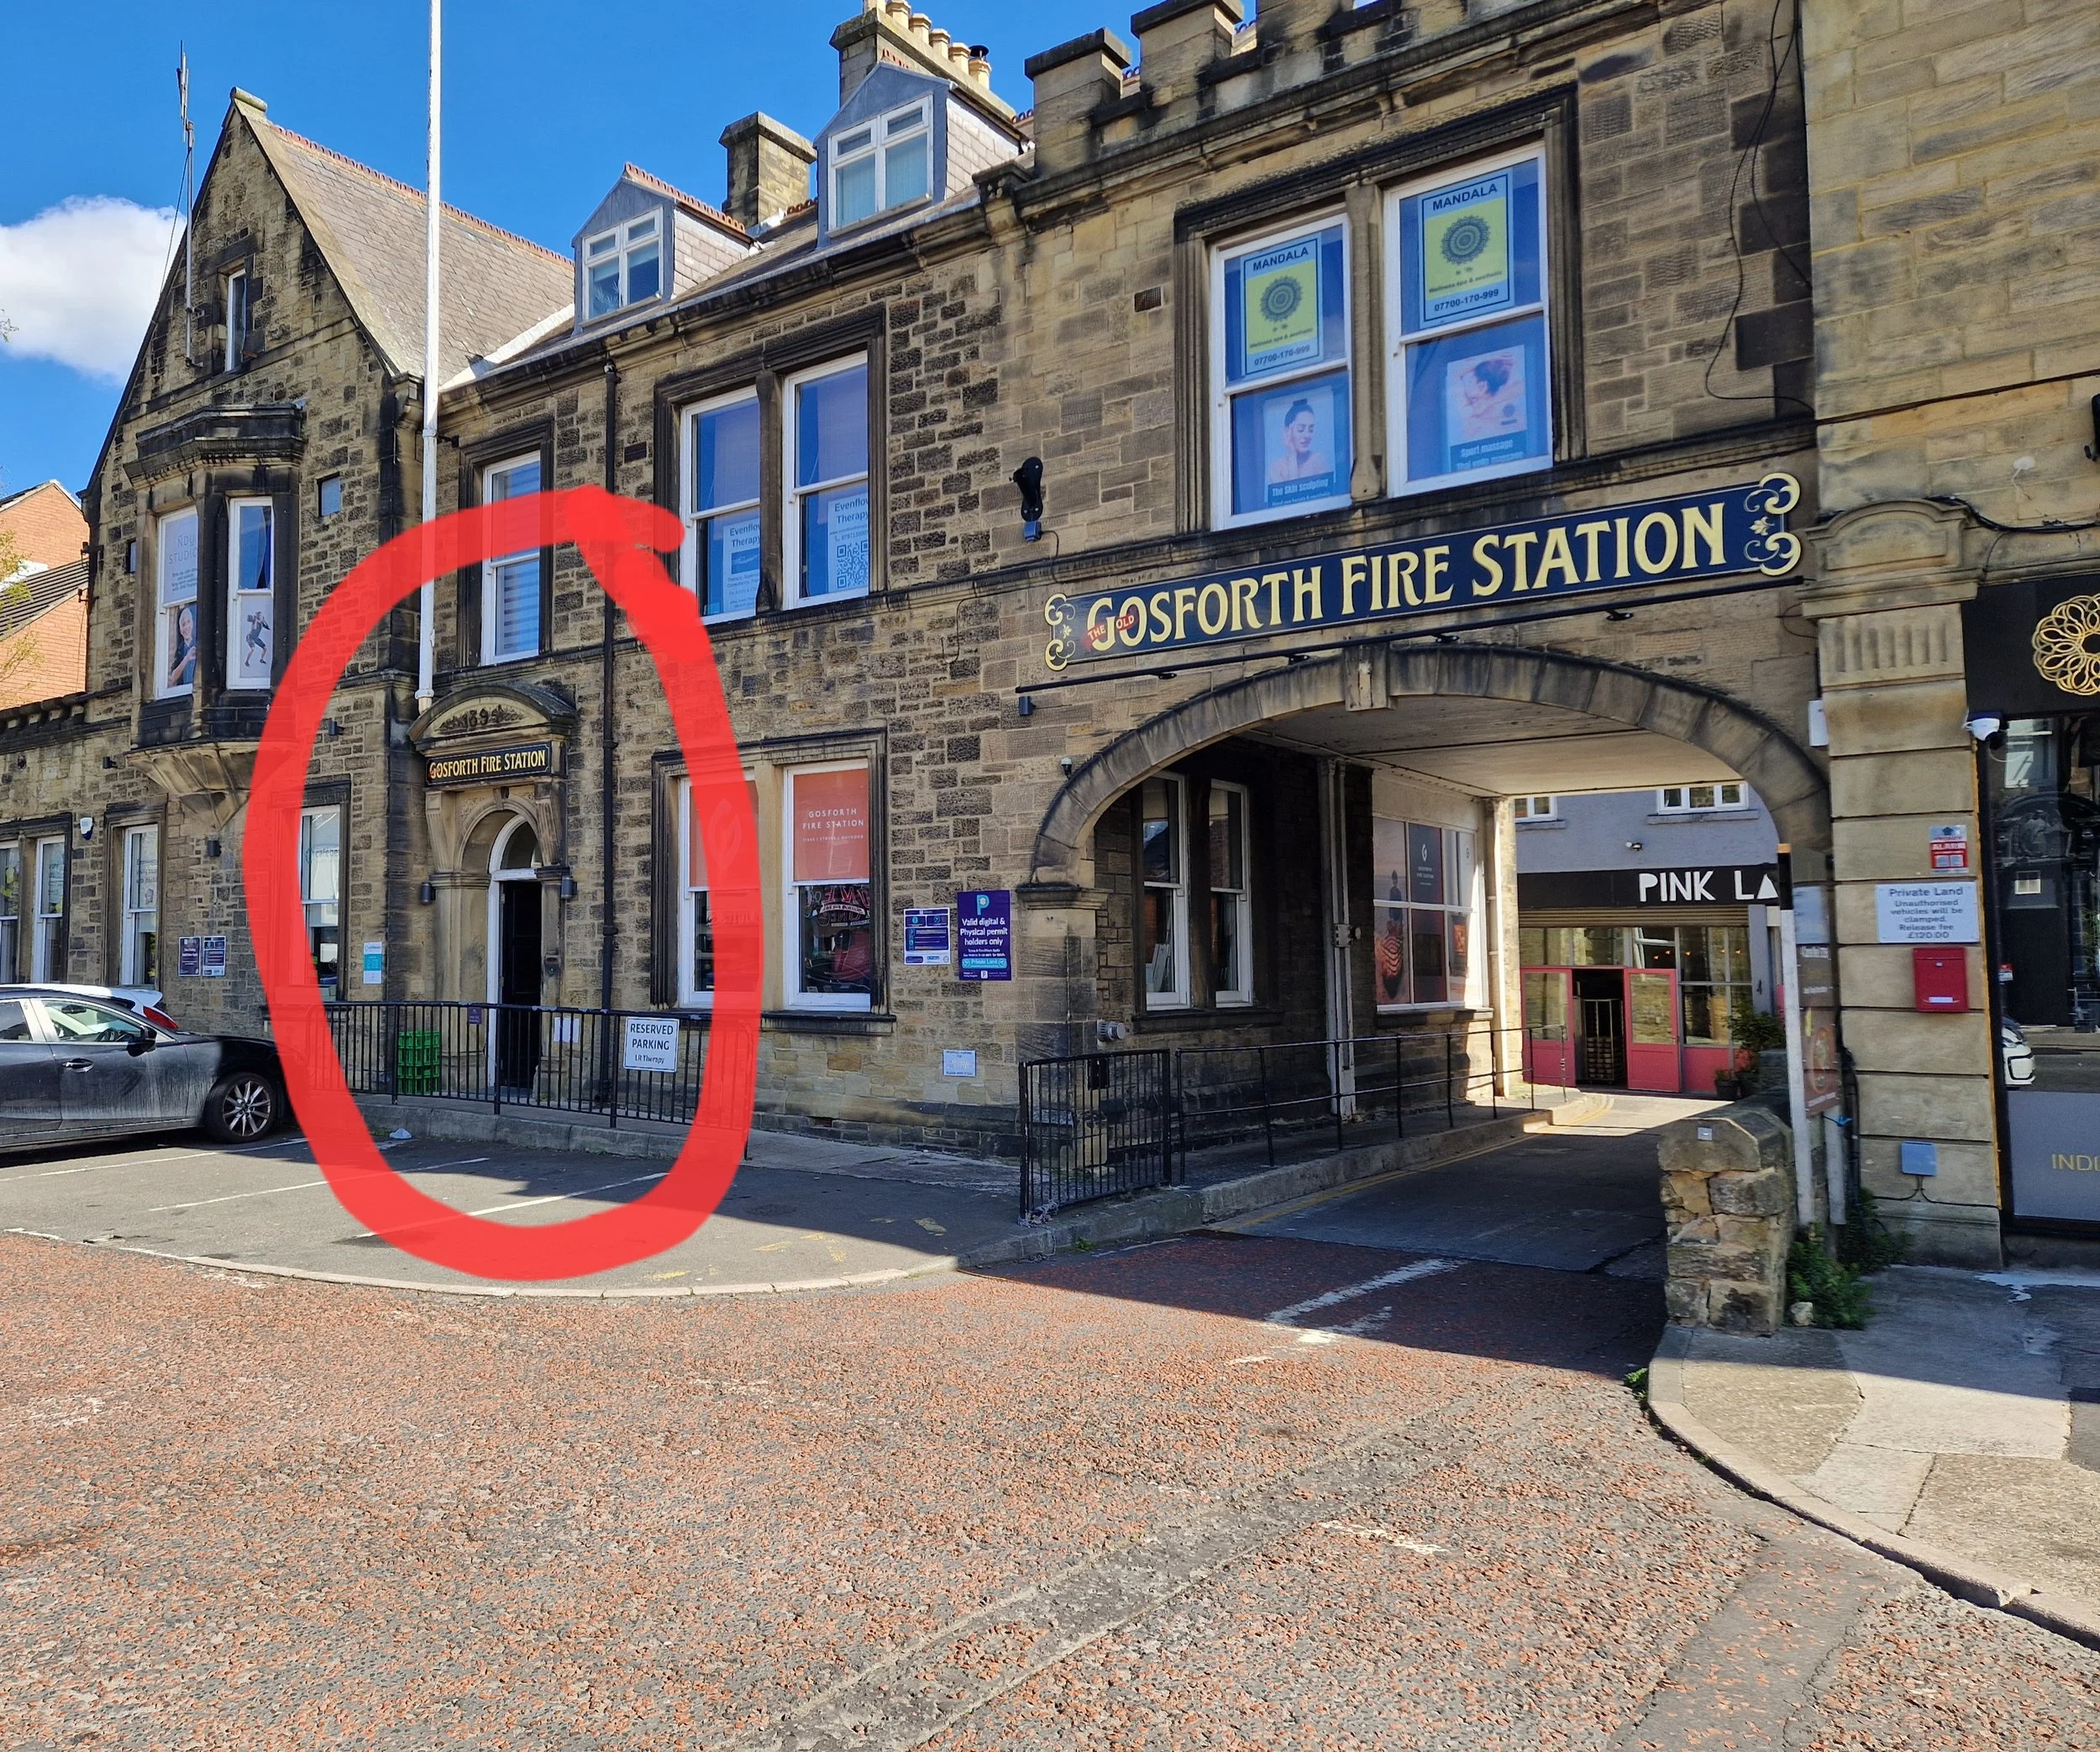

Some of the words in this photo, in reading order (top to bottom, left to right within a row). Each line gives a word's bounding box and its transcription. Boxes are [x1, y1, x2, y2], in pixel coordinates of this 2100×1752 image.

[1432, 183, 1498, 211] MANDALA
[1252, 247, 1309, 271] MANDALA
[1434, 288, 1499, 312] 07700-170-999
[1254, 344, 1310, 365] 07700-170-999
[1272, 487, 1284, 497] The
[1087, 565, 1323, 652] GOSFORTH
[1341, 544, 1454, 616] FIRE
[1472, 503, 1725, 597] STATION
[1087, 625, 1106, 641] THE
[1116, 615, 1135, 629] OLD
[429, 758, 479, 779] GOSFORTH
[480, 756, 501, 773] FIRE
[504, 749, 546, 769] STATION
[808, 807, 857, 818] GOSFORTH
[802, 821, 822, 831] FIRE
[826, 819, 864, 829] STATION
[1639, 870, 1716, 902] PINK
[1935, 887, 1963, 896] Land
[962, 918, 979, 926] Valid
[979, 916, 999, 928] digital
[960, 928, 985, 938] Physical
[986, 926, 1008, 937] permit
[964, 937, 989, 947] holders
[989, 937, 1003, 947] only
[630, 1023, 674, 1035] RESERVED
[632, 1038, 669, 1051] PARKING
[643, 1055, 665, 1064] Therapy
